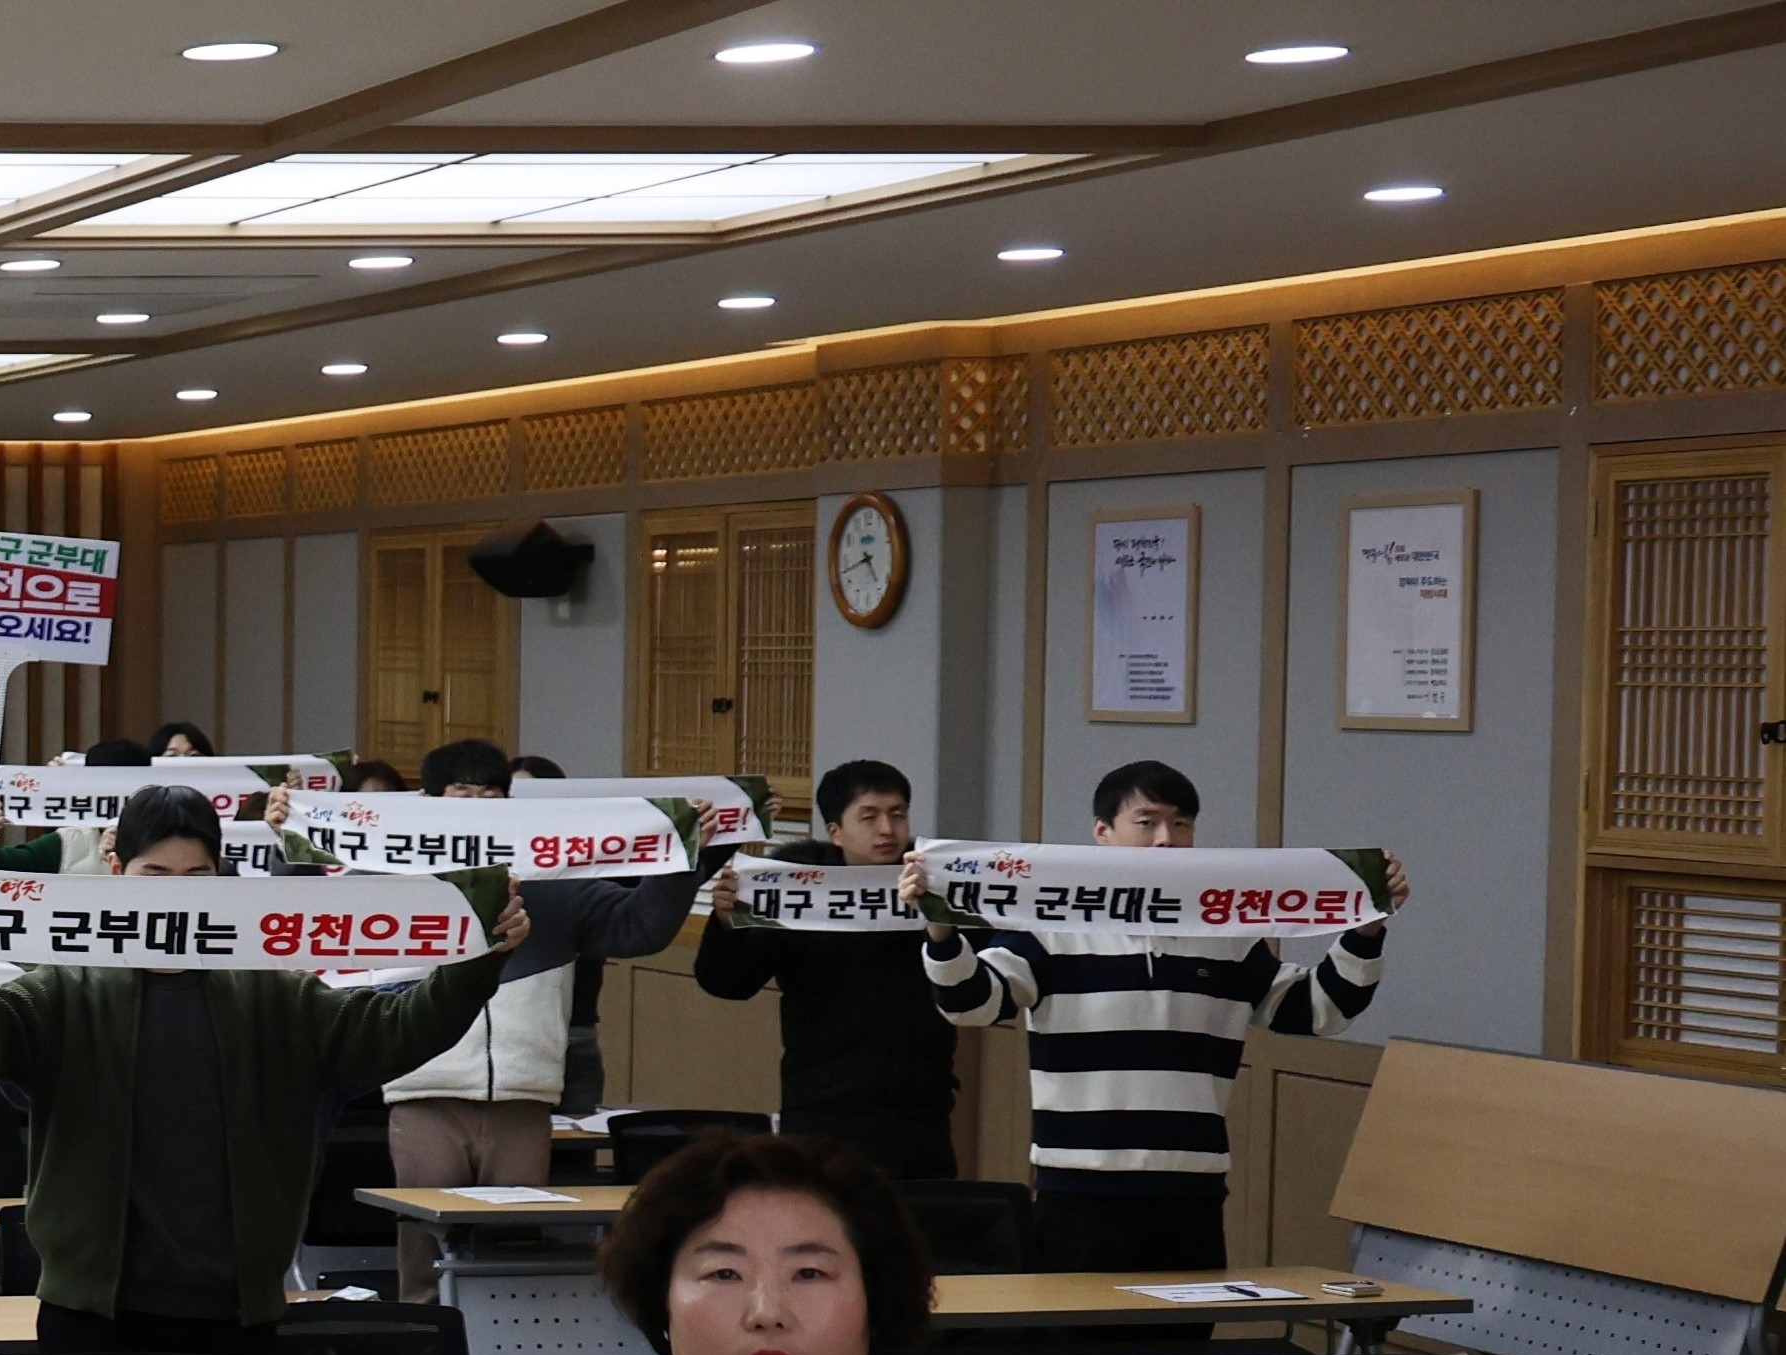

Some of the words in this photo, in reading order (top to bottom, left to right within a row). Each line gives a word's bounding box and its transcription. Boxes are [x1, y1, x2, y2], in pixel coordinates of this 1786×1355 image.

[26, 538, 107, 573] 군부대
[44, 797, 128, 822] 군부대
[308, 826, 369, 860] 대구
[384, 831, 515, 867] 군부대는
[530, 831, 673, 868] 영천으로!
[753, 887, 814, 921] 대구
[828, 888, 918, 920] 군부대
[947, 881, 1019, 917] 대구
[1034, 886, 1182, 924] 군부대는
[1199, 889, 1363, 925] 영천으로!
[49, 907, 237, 954] 군부대는
[260, 912, 470, 956] 영천으로!
